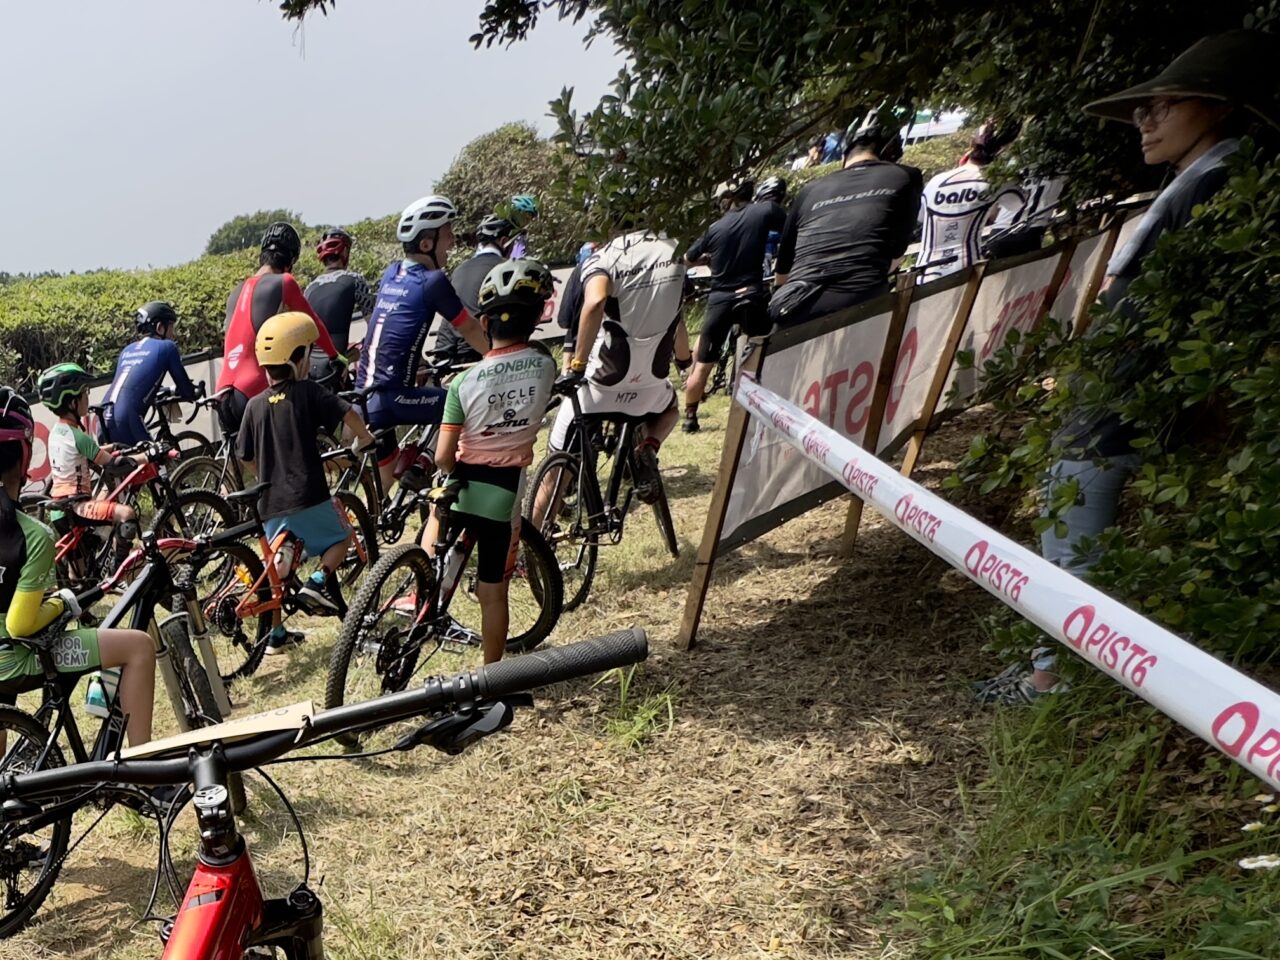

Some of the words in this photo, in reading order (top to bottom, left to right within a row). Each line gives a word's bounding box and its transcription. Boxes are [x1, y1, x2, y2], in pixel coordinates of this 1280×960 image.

[477, 358, 543, 382] AEONBIKE
[488, 386, 536, 404] CYCLE
[488, 396, 535, 411] TERRACE
[616, 392, 638, 403] MTP
[851, 469, 880, 498] PIST6
[905, 506, 942, 543] PIST6
[980, 554, 1029, 602] PIST6
[1085, 623, 1158, 688] PIST6
